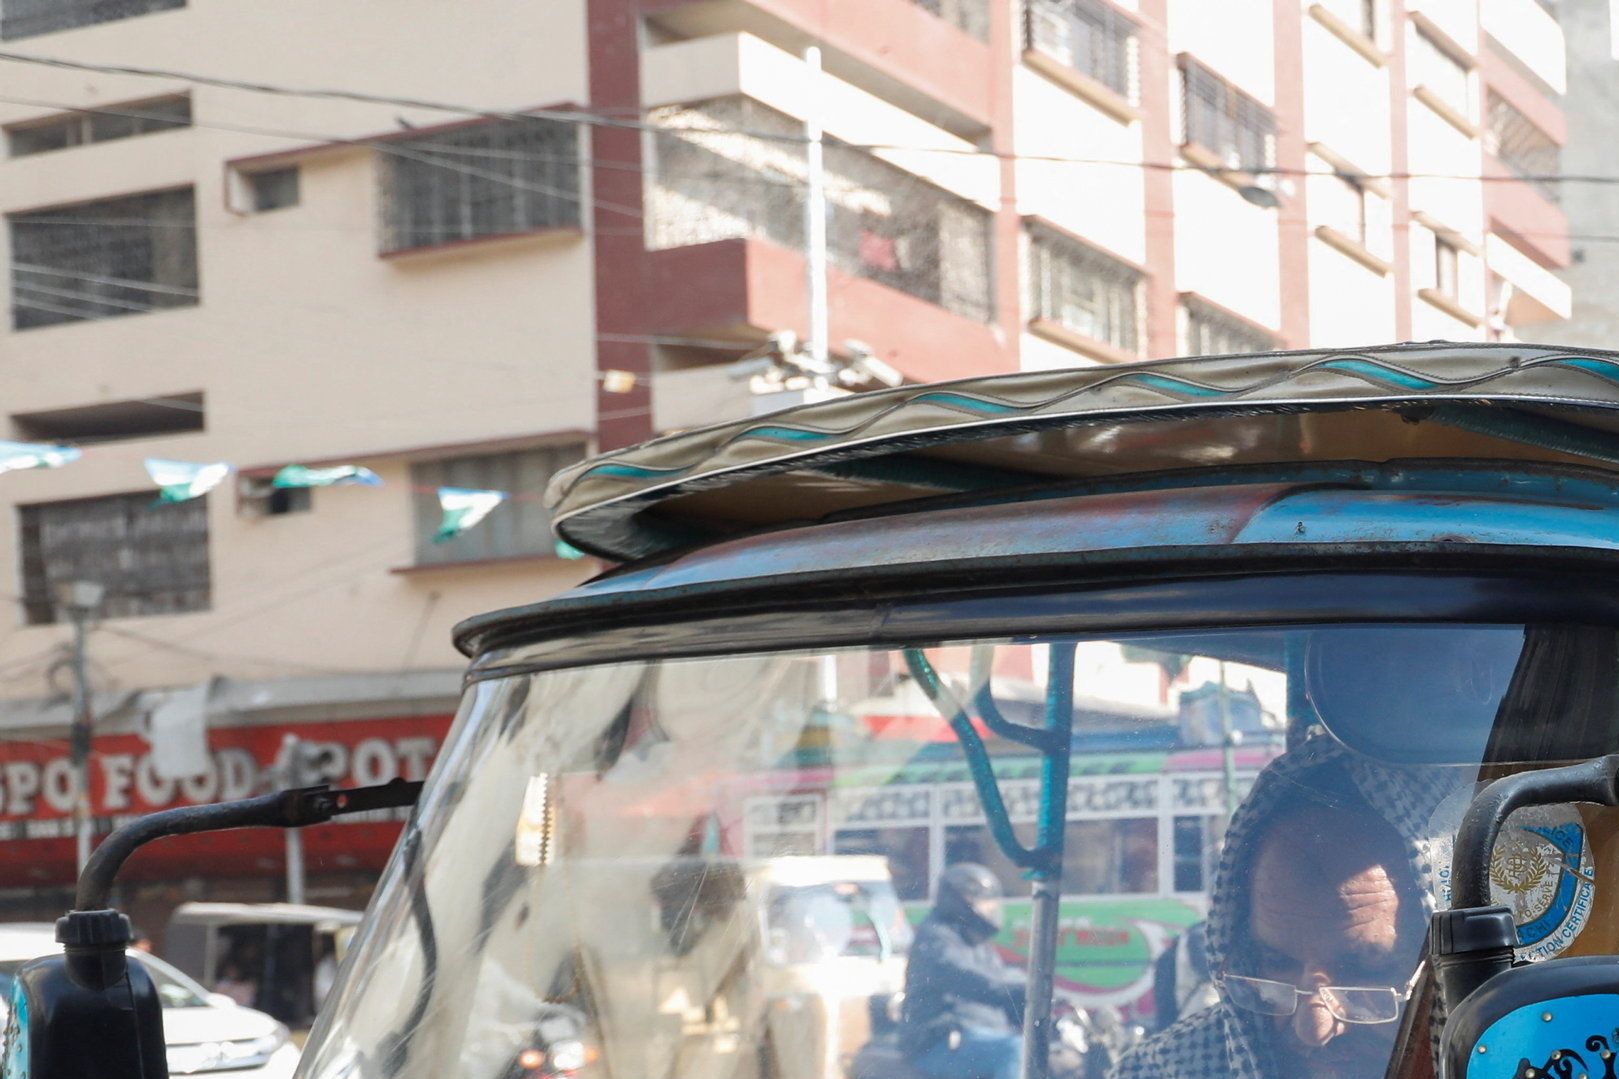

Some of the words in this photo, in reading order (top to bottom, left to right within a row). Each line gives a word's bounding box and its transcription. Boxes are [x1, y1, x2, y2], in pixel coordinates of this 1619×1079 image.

[0, 756, 82, 816] PO
[284, 736, 437, 795] POT
[1561, 867, 1594, 938] CERTIFICAE
